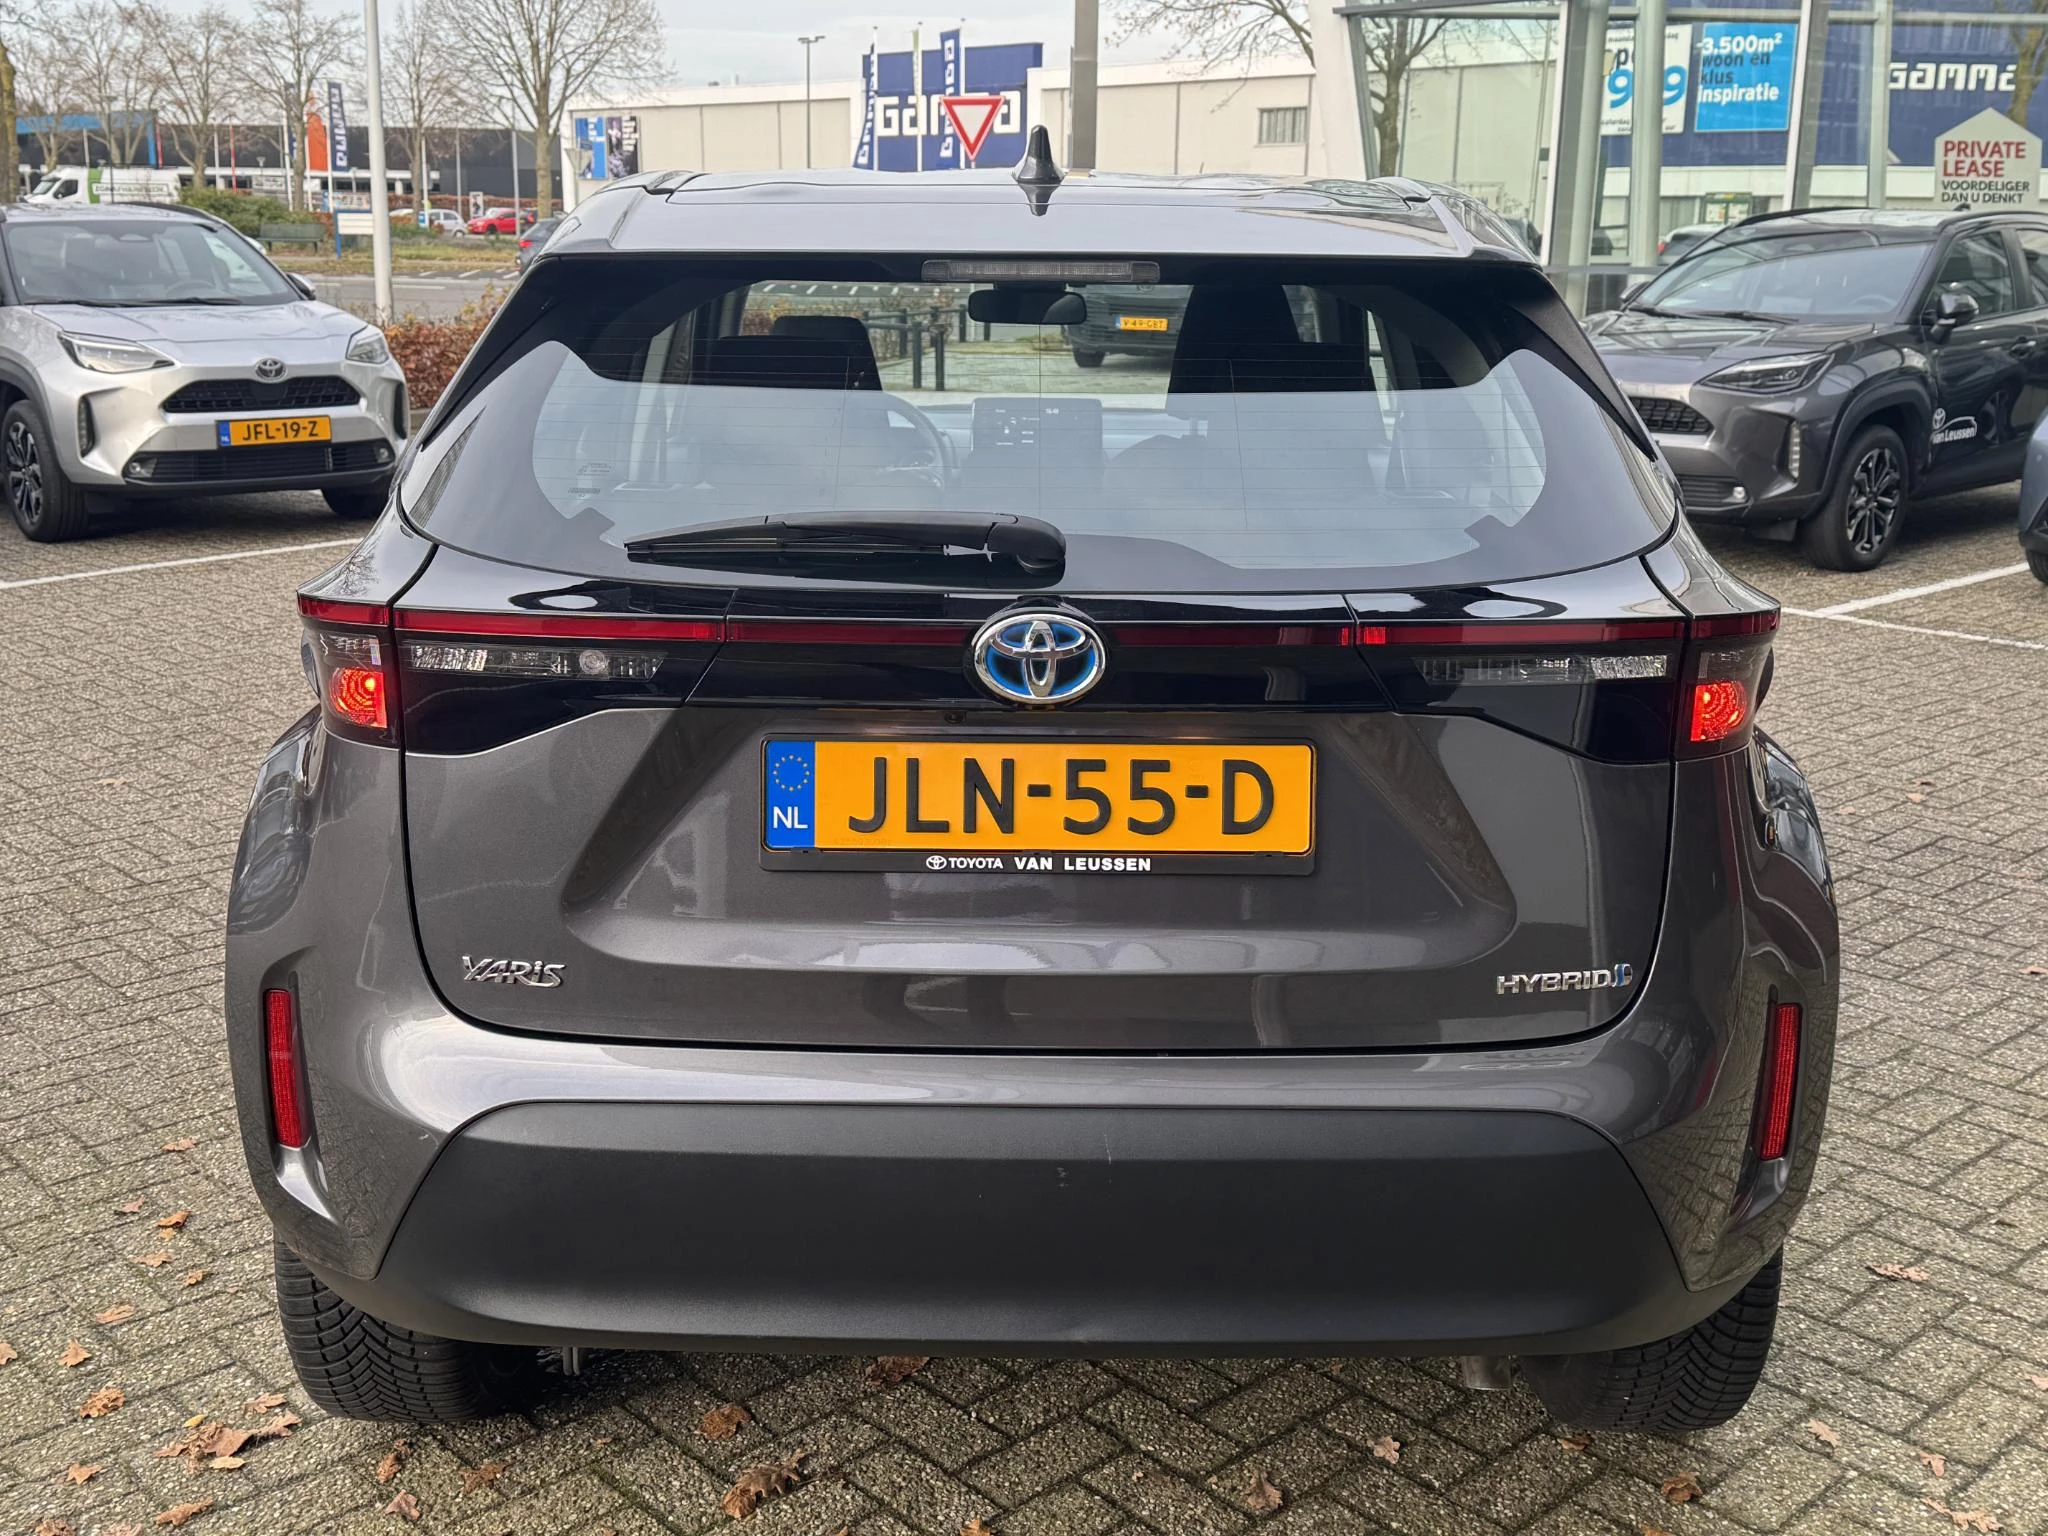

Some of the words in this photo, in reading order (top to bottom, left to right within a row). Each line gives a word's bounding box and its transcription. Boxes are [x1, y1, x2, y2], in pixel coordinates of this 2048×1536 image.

[1702, 54, 1744, 67] woon
[1750, 52, 1771, 65] en
[1701, 70, 1734, 84] klus
[1698, 82, 1780, 106] inspiratie
[1943, 140, 2026, 158] PRIVATE
[1943, 160, 2005, 177] LEASE
[1942, 180, 2030, 192] VOORDELIGER
[1941, 192, 1969, 203] DAN
[1971, 193, 1980, 203] U
[1982, 192, 2024, 204] DENKT
[242, 420, 318, 441] JFL-19-Z
[848, 756, 1275, 836] JLN-55-D
[772, 806, 808, 829] NL
[949, 857, 1003, 870] TOYOTA
[1014, 857, 1053, 871] VAN
[1064, 857, 1151, 872] LEUSSEN
[1497, 969, 1611, 995] HYBRID
